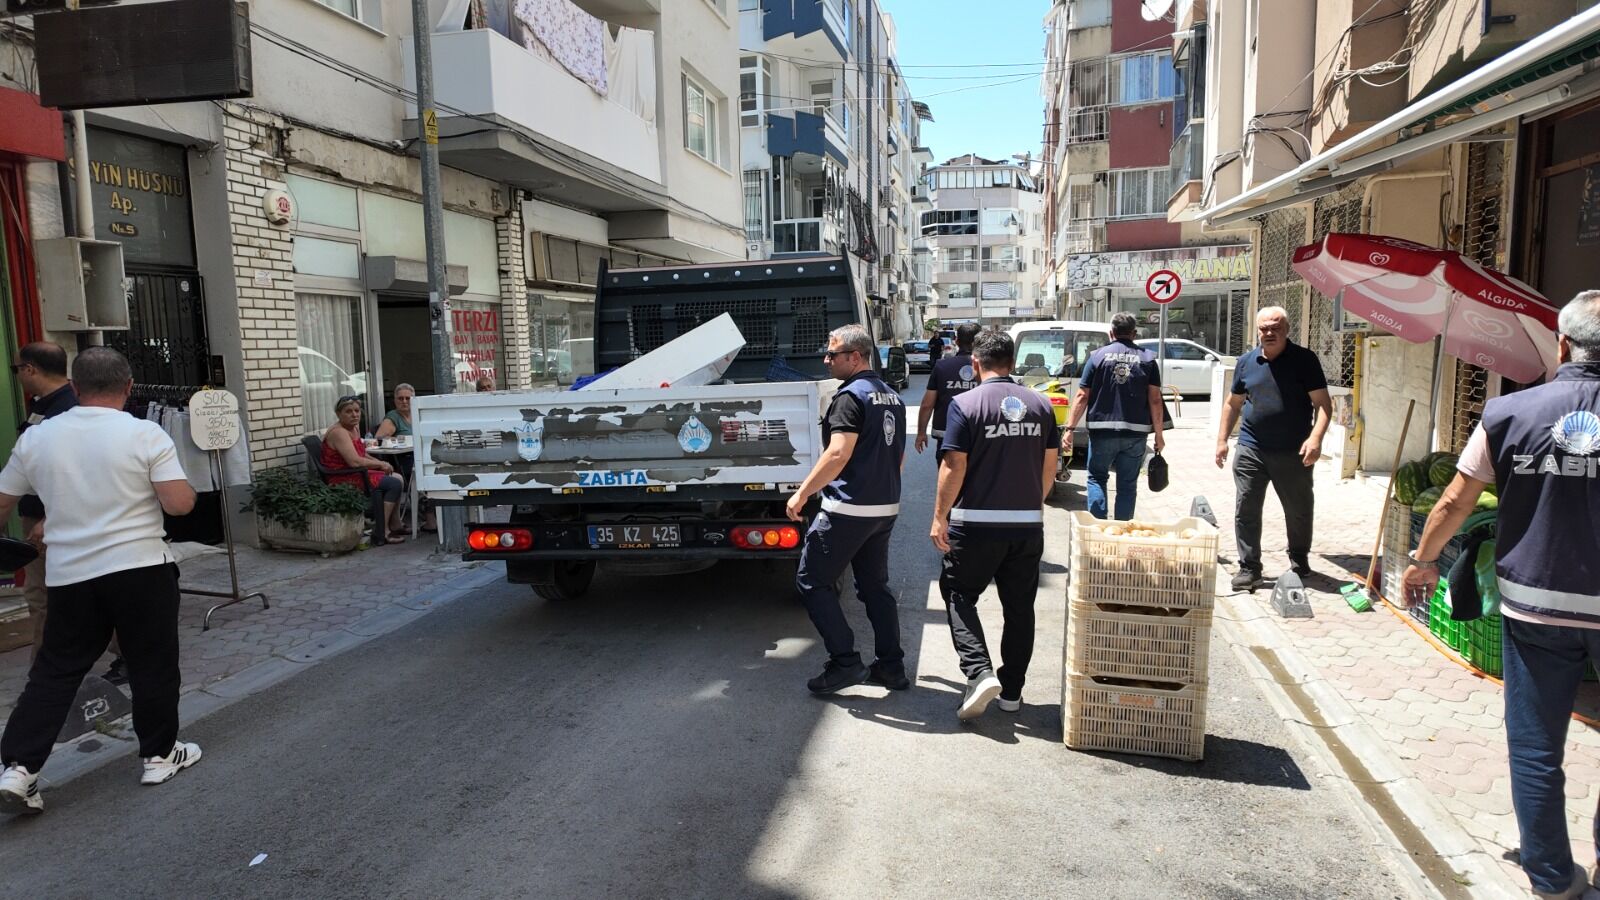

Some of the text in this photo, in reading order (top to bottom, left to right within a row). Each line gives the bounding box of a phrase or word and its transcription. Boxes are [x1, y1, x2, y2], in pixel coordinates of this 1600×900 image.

[127, 167, 184, 197] HÜSNÜ
[110, 191, 137, 215] Ap.
[1168, 252, 1254, 281] MANA
[984, 422, 1042, 439] ZABITA
[1512, 454, 1600, 478] ZABI
[597, 526, 678, 542] 35 KZ 425
